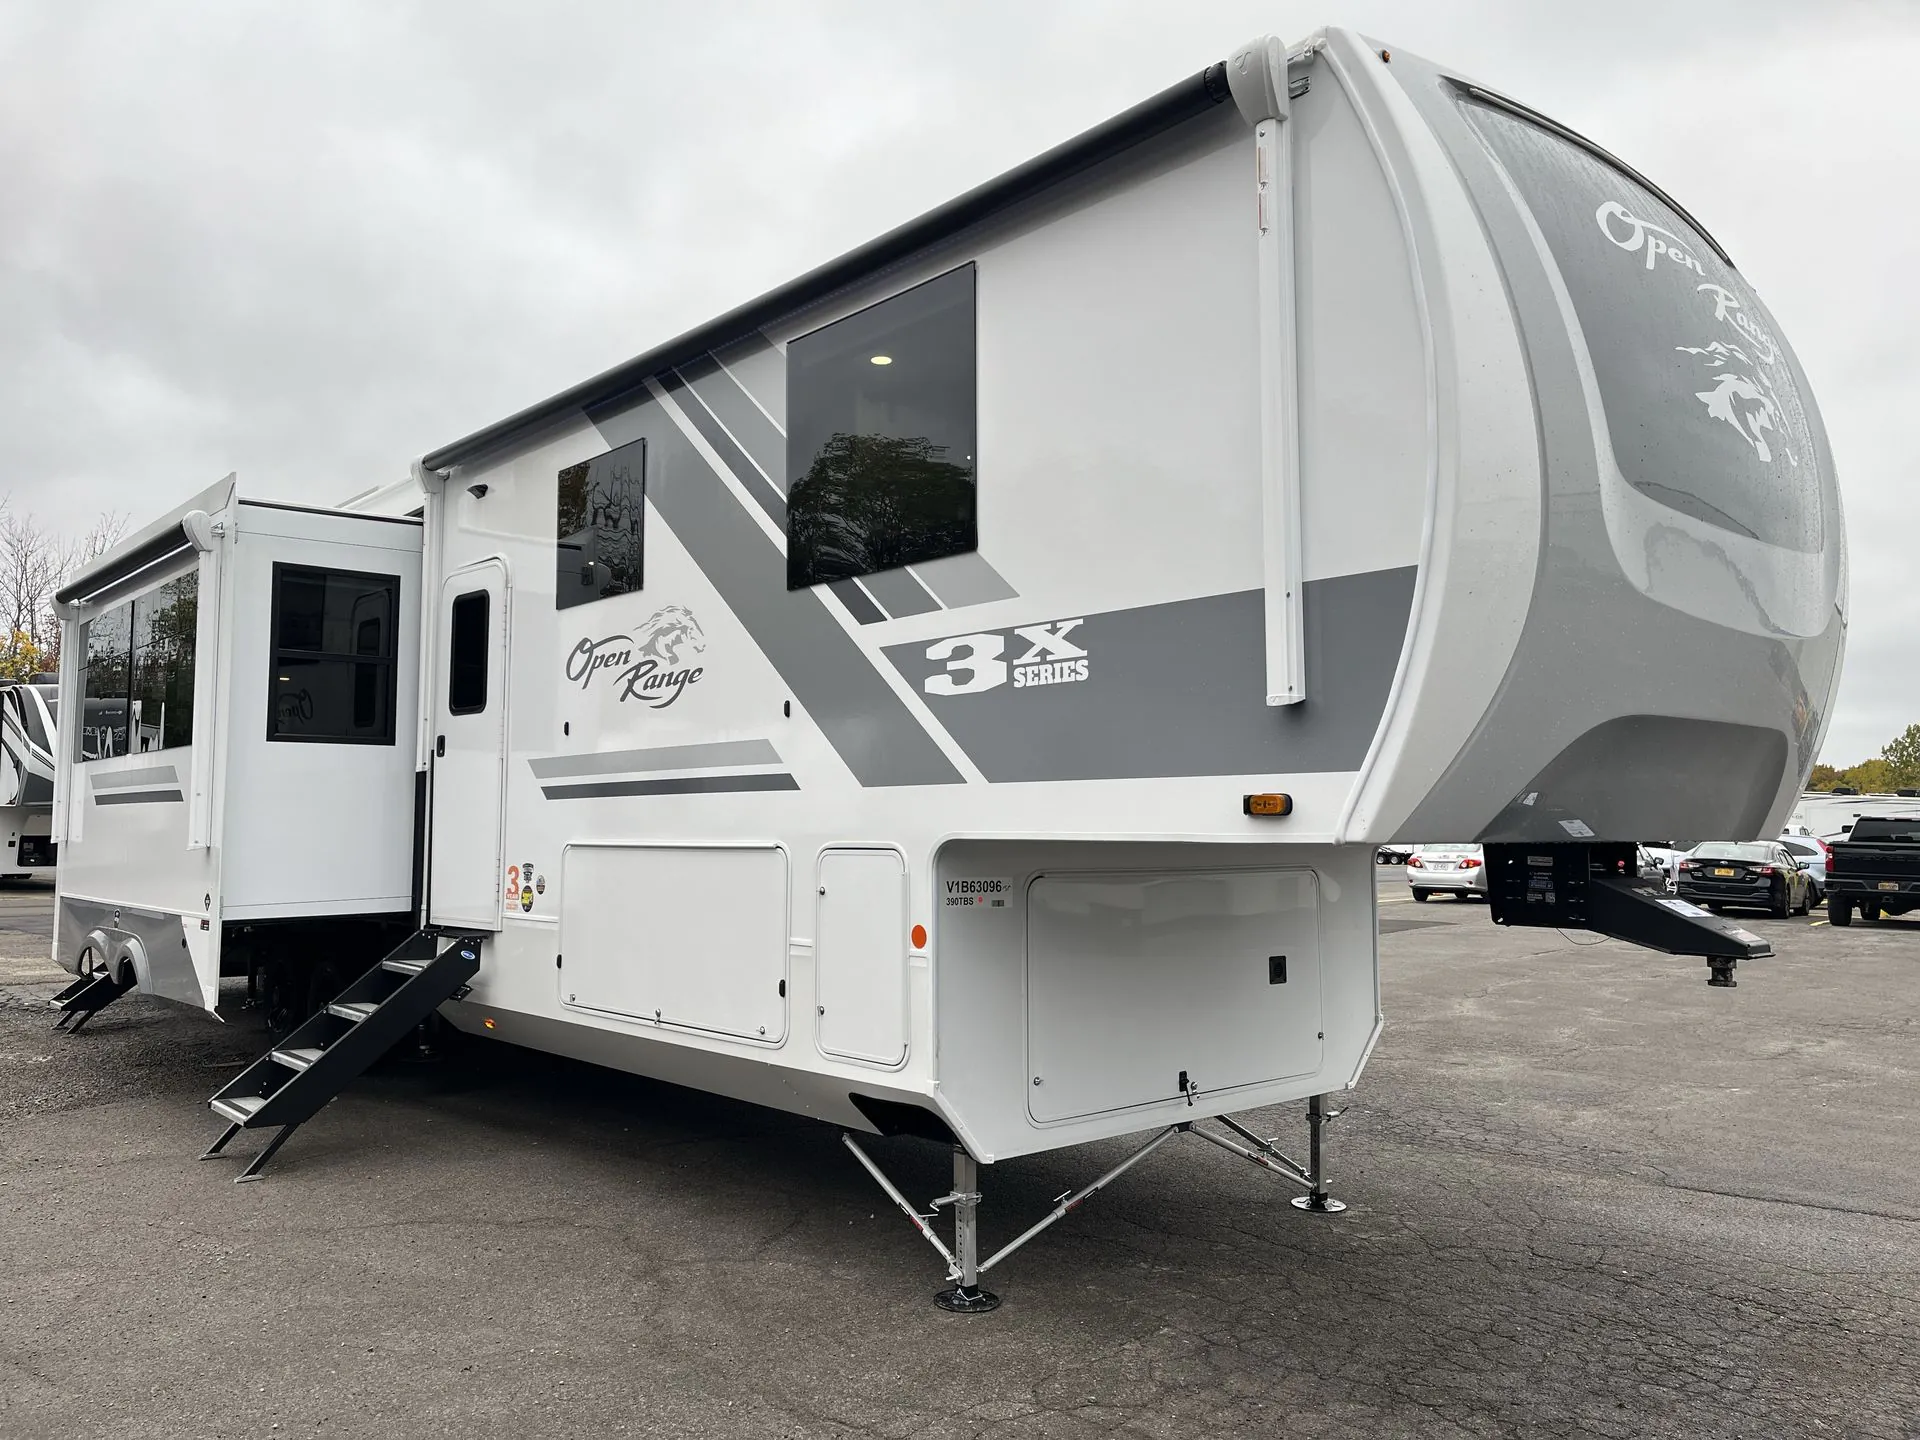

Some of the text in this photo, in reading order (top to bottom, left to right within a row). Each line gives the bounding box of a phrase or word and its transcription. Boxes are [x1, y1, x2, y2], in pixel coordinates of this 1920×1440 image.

[1596, 200, 1706, 276] Open
[565, 634, 635, 690] Open
[1013, 659, 1089, 688] SERIES
[612, 659, 704, 709] Range
[945, 896, 974, 906] 390TBS
[946, 880, 1002, 893] V1B63096
